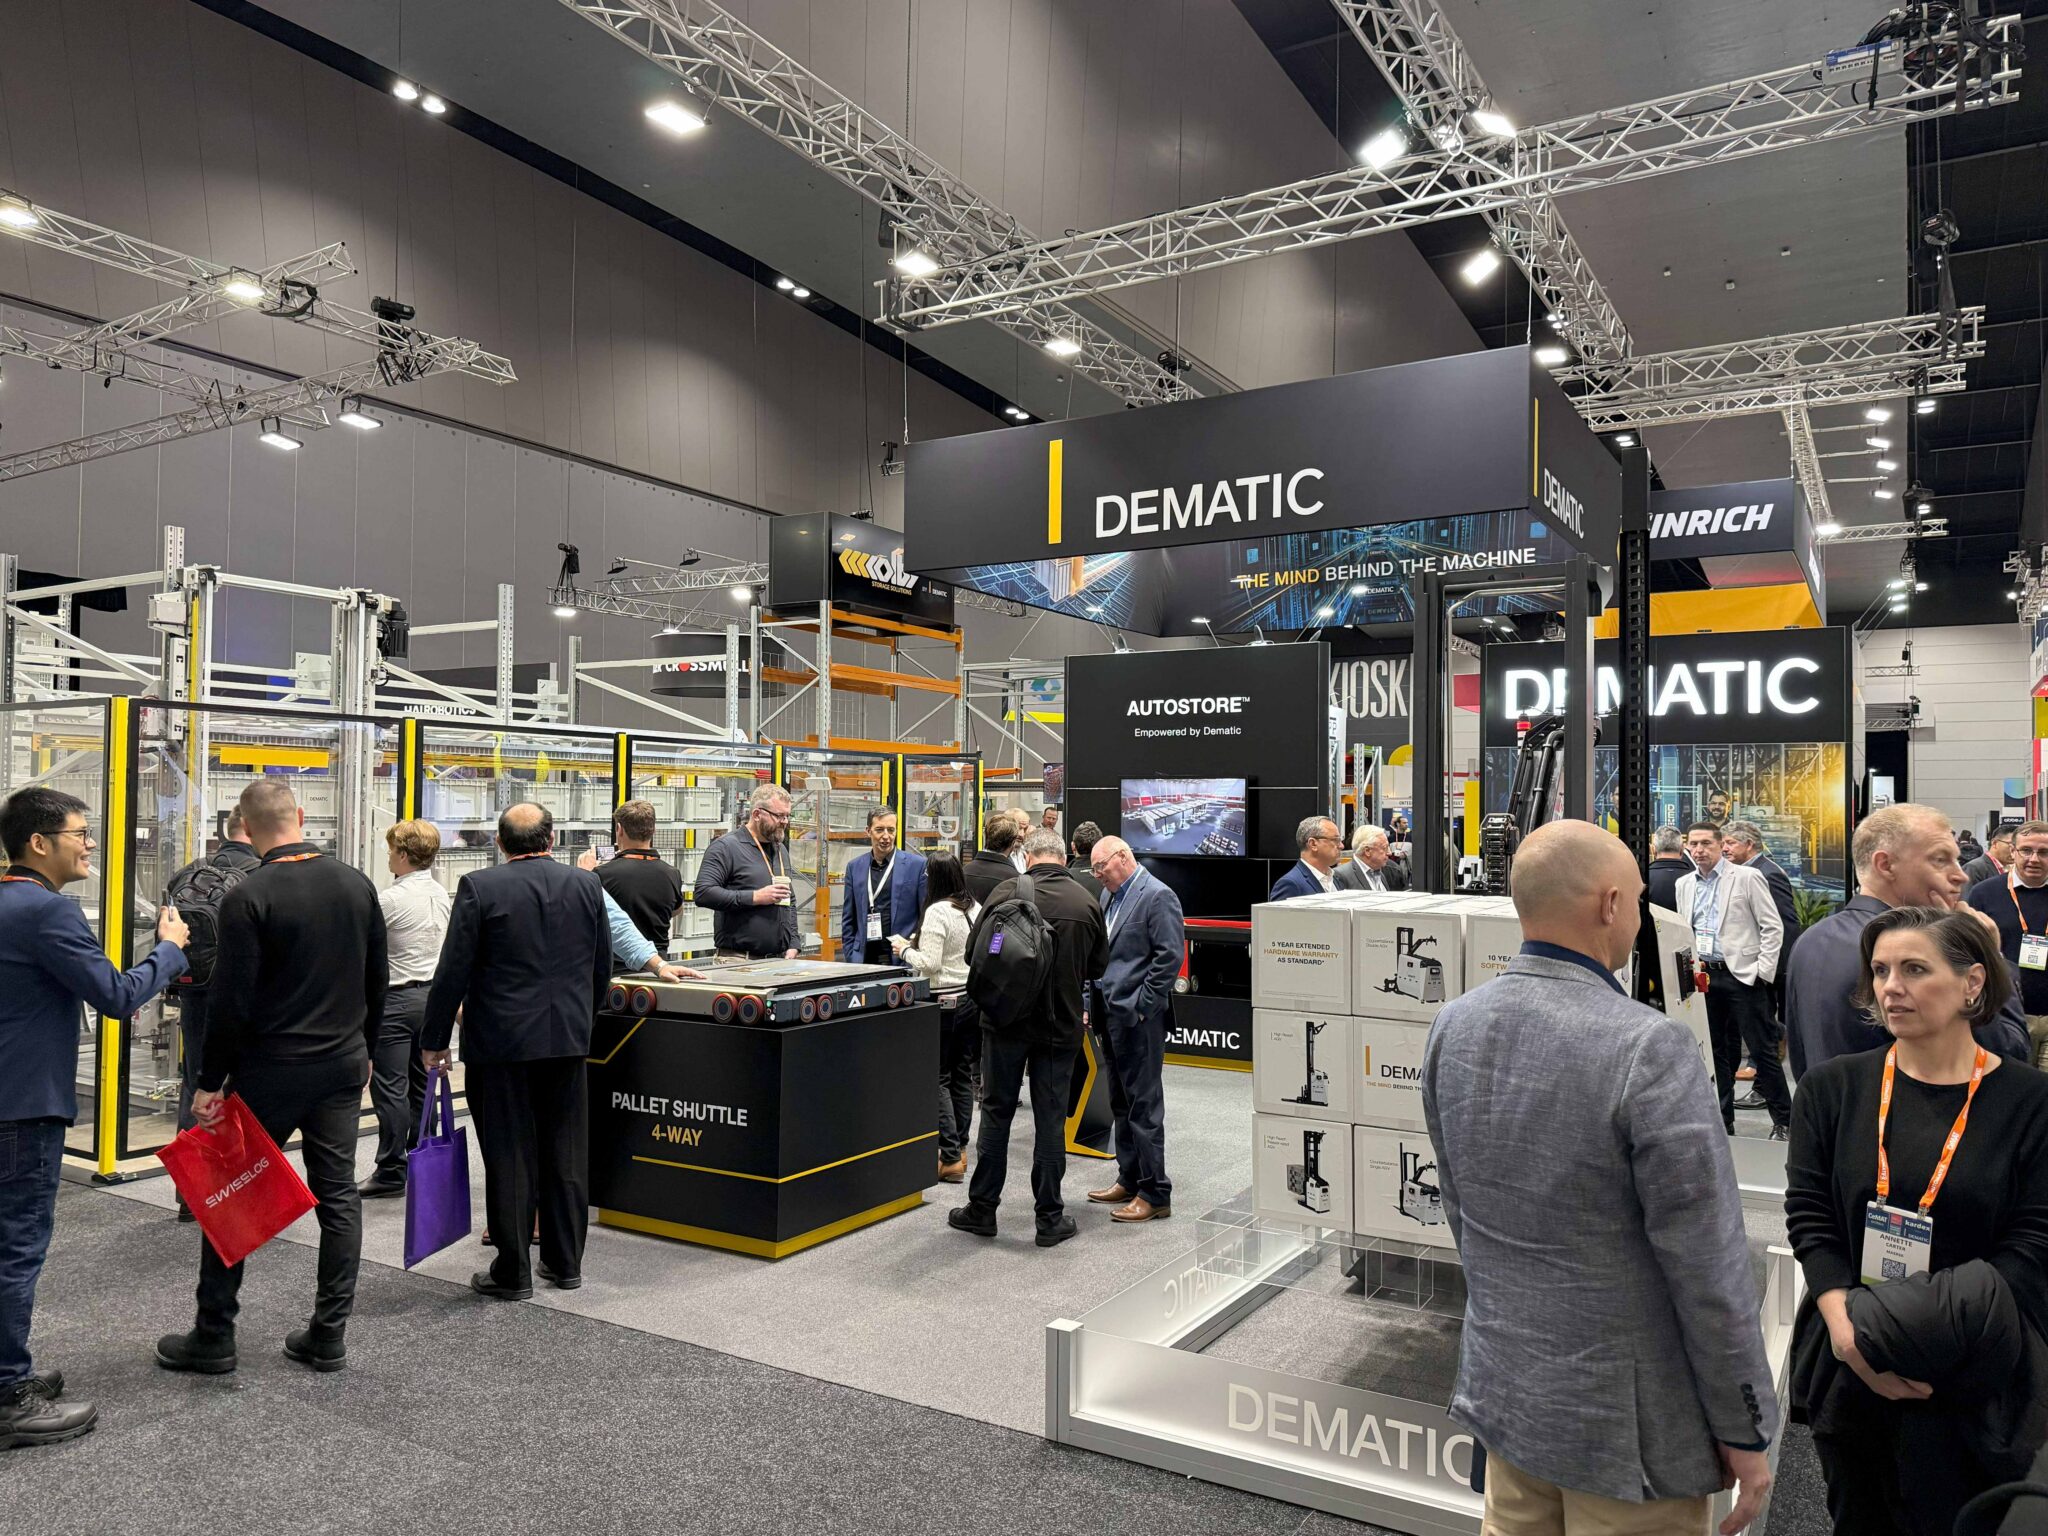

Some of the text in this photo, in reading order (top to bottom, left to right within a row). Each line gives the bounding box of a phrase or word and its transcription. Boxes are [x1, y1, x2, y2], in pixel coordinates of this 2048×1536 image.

[1095, 467, 1325, 538] DEMATIC
[1543, 467, 1585, 539] DEMATIC
[1647, 503, 1775, 539] INRICH
[1236, 547, 1537, 590] THE MIND BEHIND THE MACHINE
[871, 581, 913, 596] STORAGE SOLUTIONS
[1367, 586, 1395, 595] DEMATIC
[1329, 659, 1409, 719] KIOSK
[1503, 657, 1821, 720] DMATIC
[1134, 725, 1242, 740] Empowered by Dematic
[1263, 949, 1339, 959] HARDWARE WARRANTY
[1295, 943, 1331, 951] EXTENDED
[611, 1091, 748, 1128] PALLET SHUTTLE
[651, 1123, 703, 1148] 4-WAY
[204, 1156, 270, 1209] SWISSLOG
[1868, 1212, 1888, 1223] CeMAT
[1904, 1219, 1931, 1232] kardex
[1879, 1233, 1913, 1248] ANNETTE
[1885, 1242, 1906, 1252] CARTER
